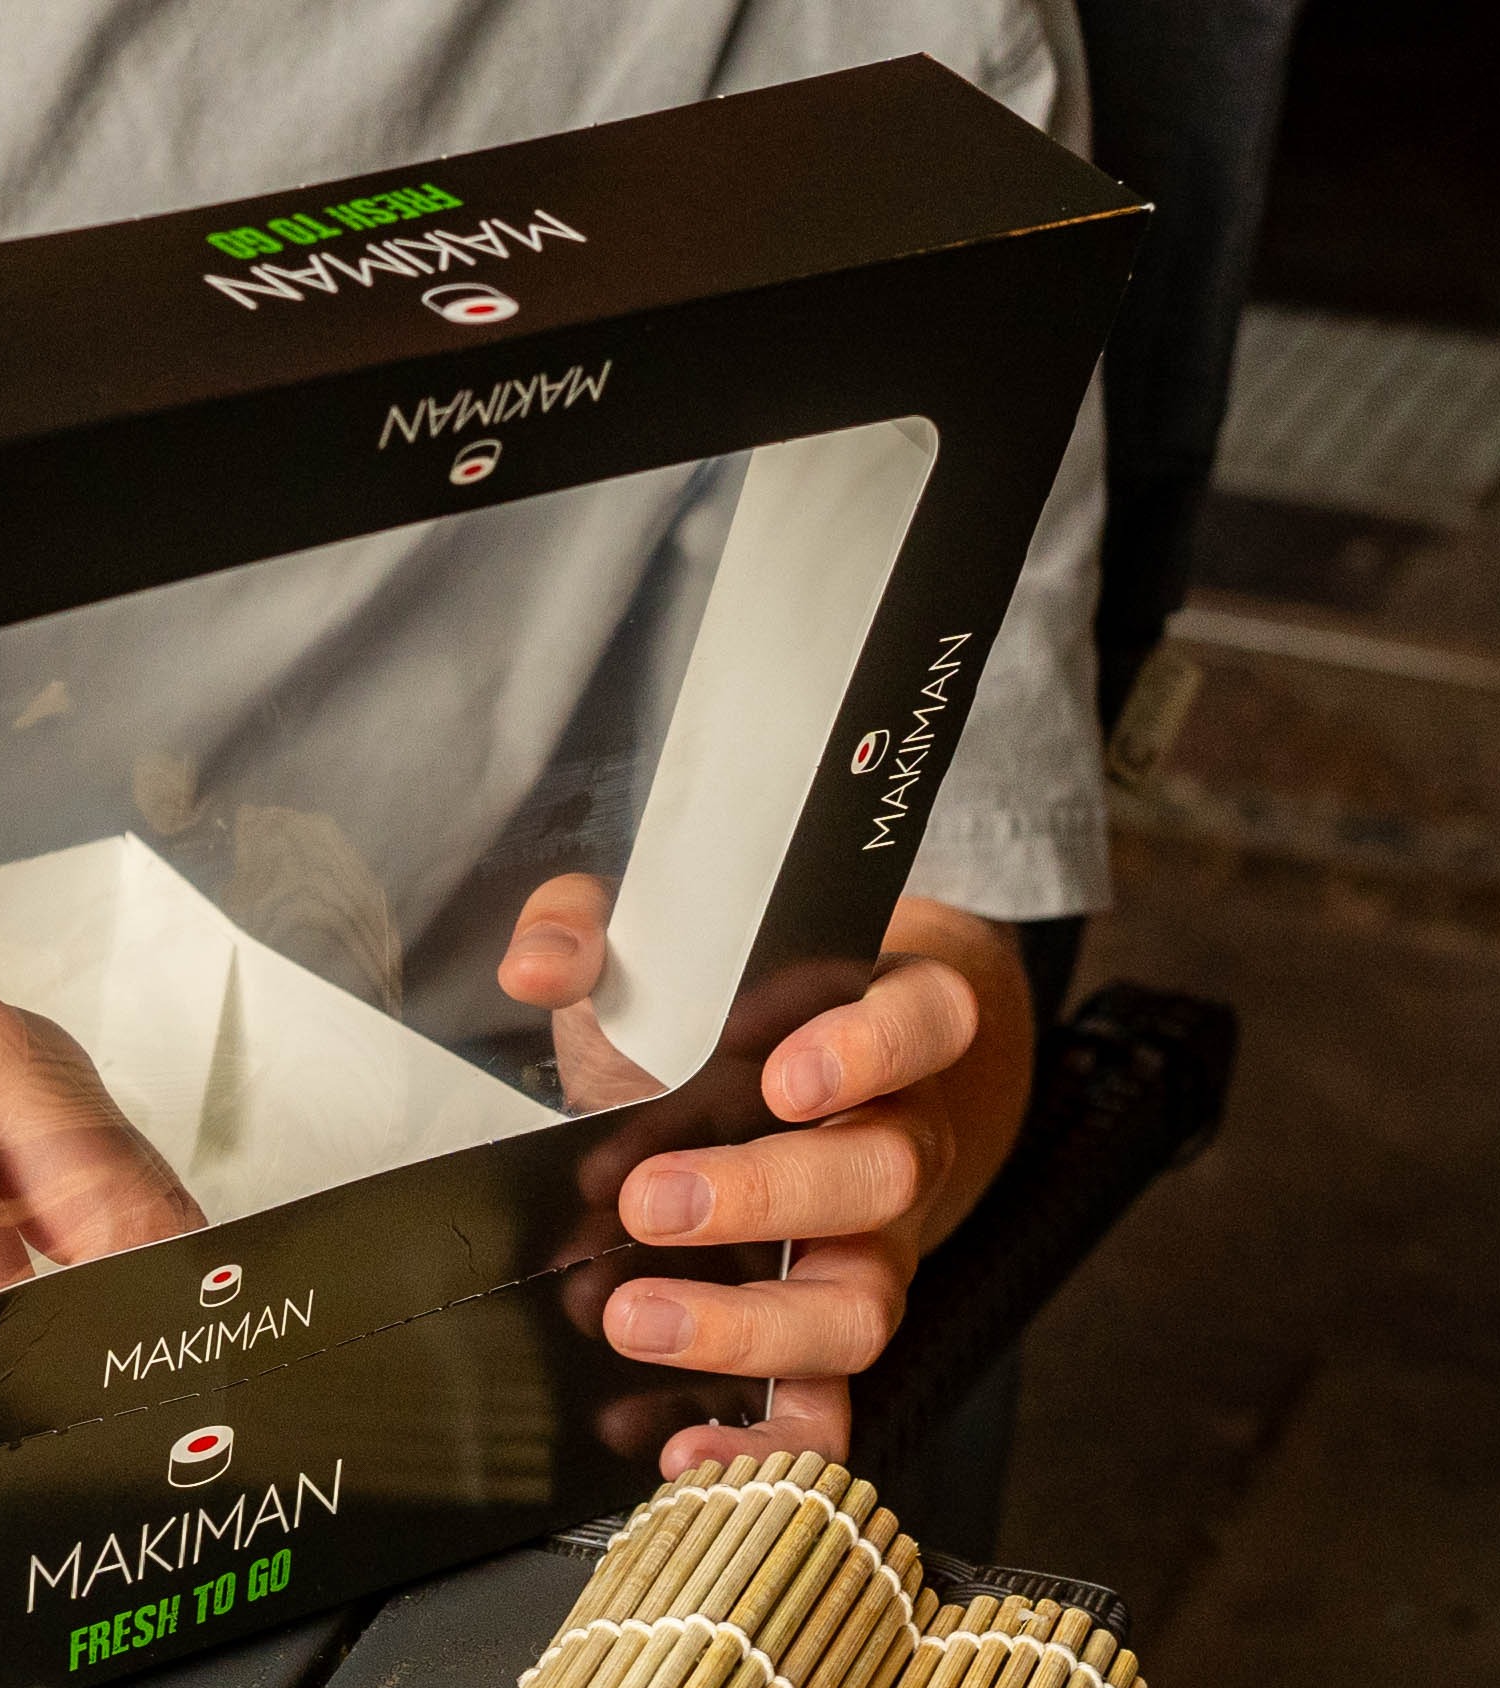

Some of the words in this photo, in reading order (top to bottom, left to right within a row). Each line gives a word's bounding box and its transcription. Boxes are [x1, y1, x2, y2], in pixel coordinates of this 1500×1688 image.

[204, 230, 285, 260] GO
[266, 212, 343, 246] TO
[330, 182, 464, 232] FRESH
[203, 209, 588, 310] MAKIMAN
[377, 359, 613, 451] MAKIMAN
[861, 632, 973, 851] MAKIMAN
[103, 1288, 315, 1389] MAKIMAN
[26, 1458, 343, 1614] MAKIMAN
[68, 1594, 182, 1672] FRESH
[193, 1571, 237, 1625] TO
[247, 1547, 293, 1603] GO
